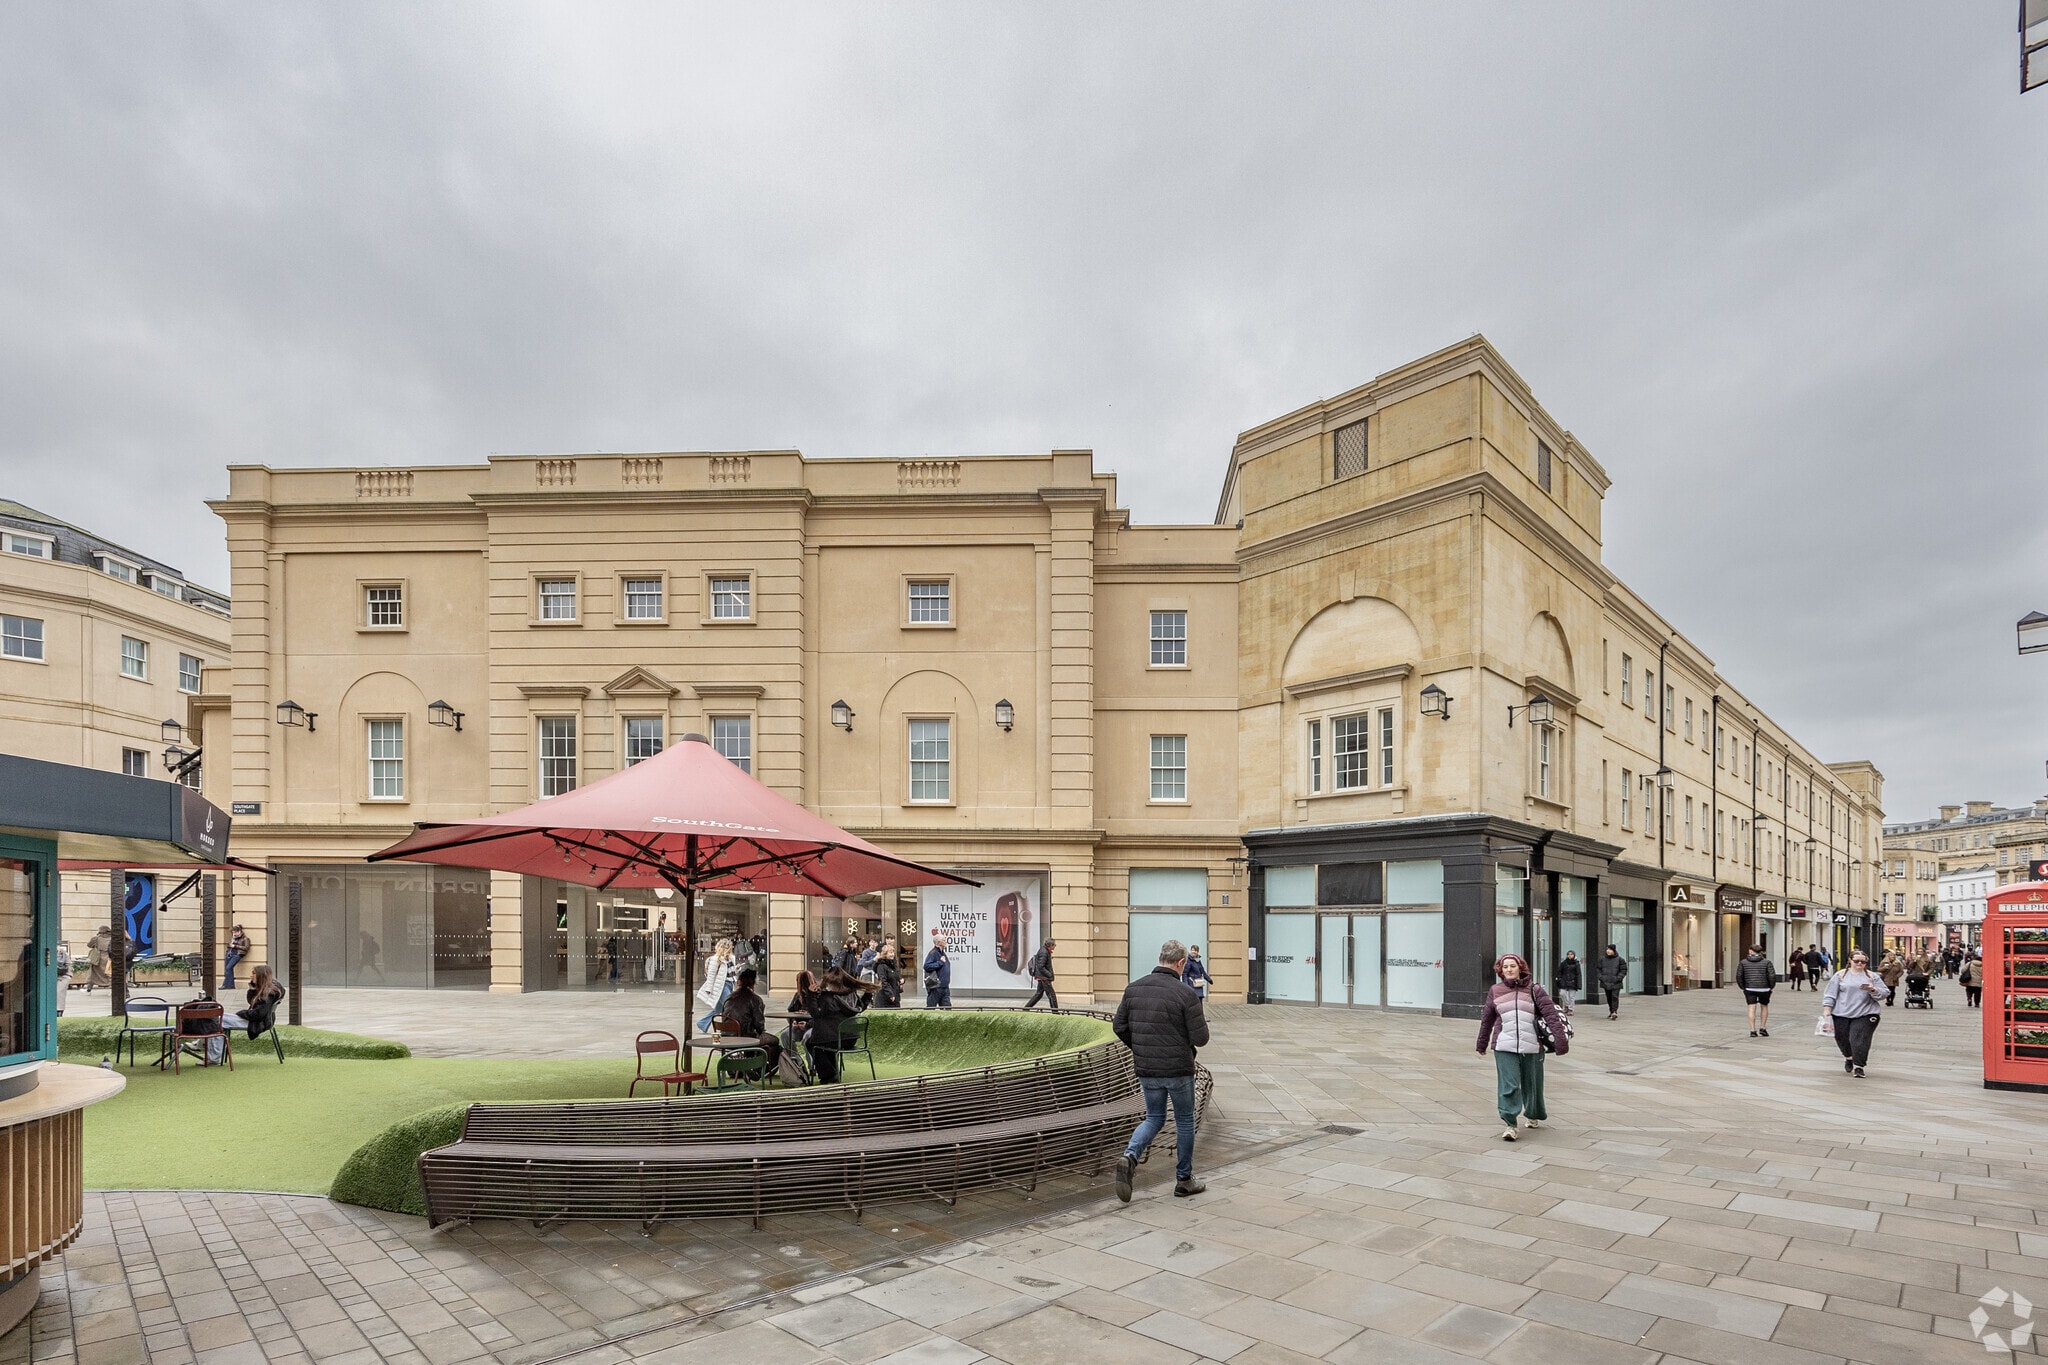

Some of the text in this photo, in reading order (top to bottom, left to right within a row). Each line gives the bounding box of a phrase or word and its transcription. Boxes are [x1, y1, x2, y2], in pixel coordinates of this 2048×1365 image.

[651, 816, 780, 833] SouthGate
[1673, 887, 1688, 901] A
[940, 904, 959, 912] THE
[1723, 900, 1743, 908] Typo
[203, 881, 215, 950] LANSDOWN
[940, 912, 988, 921] ULTIMATE
[940, 920, 976, 929] WAY TO
[940, 928, 975, 937] WATCH
[945, 937, 967, 945] OUR
[112, 948, 125, 986] DOWN
